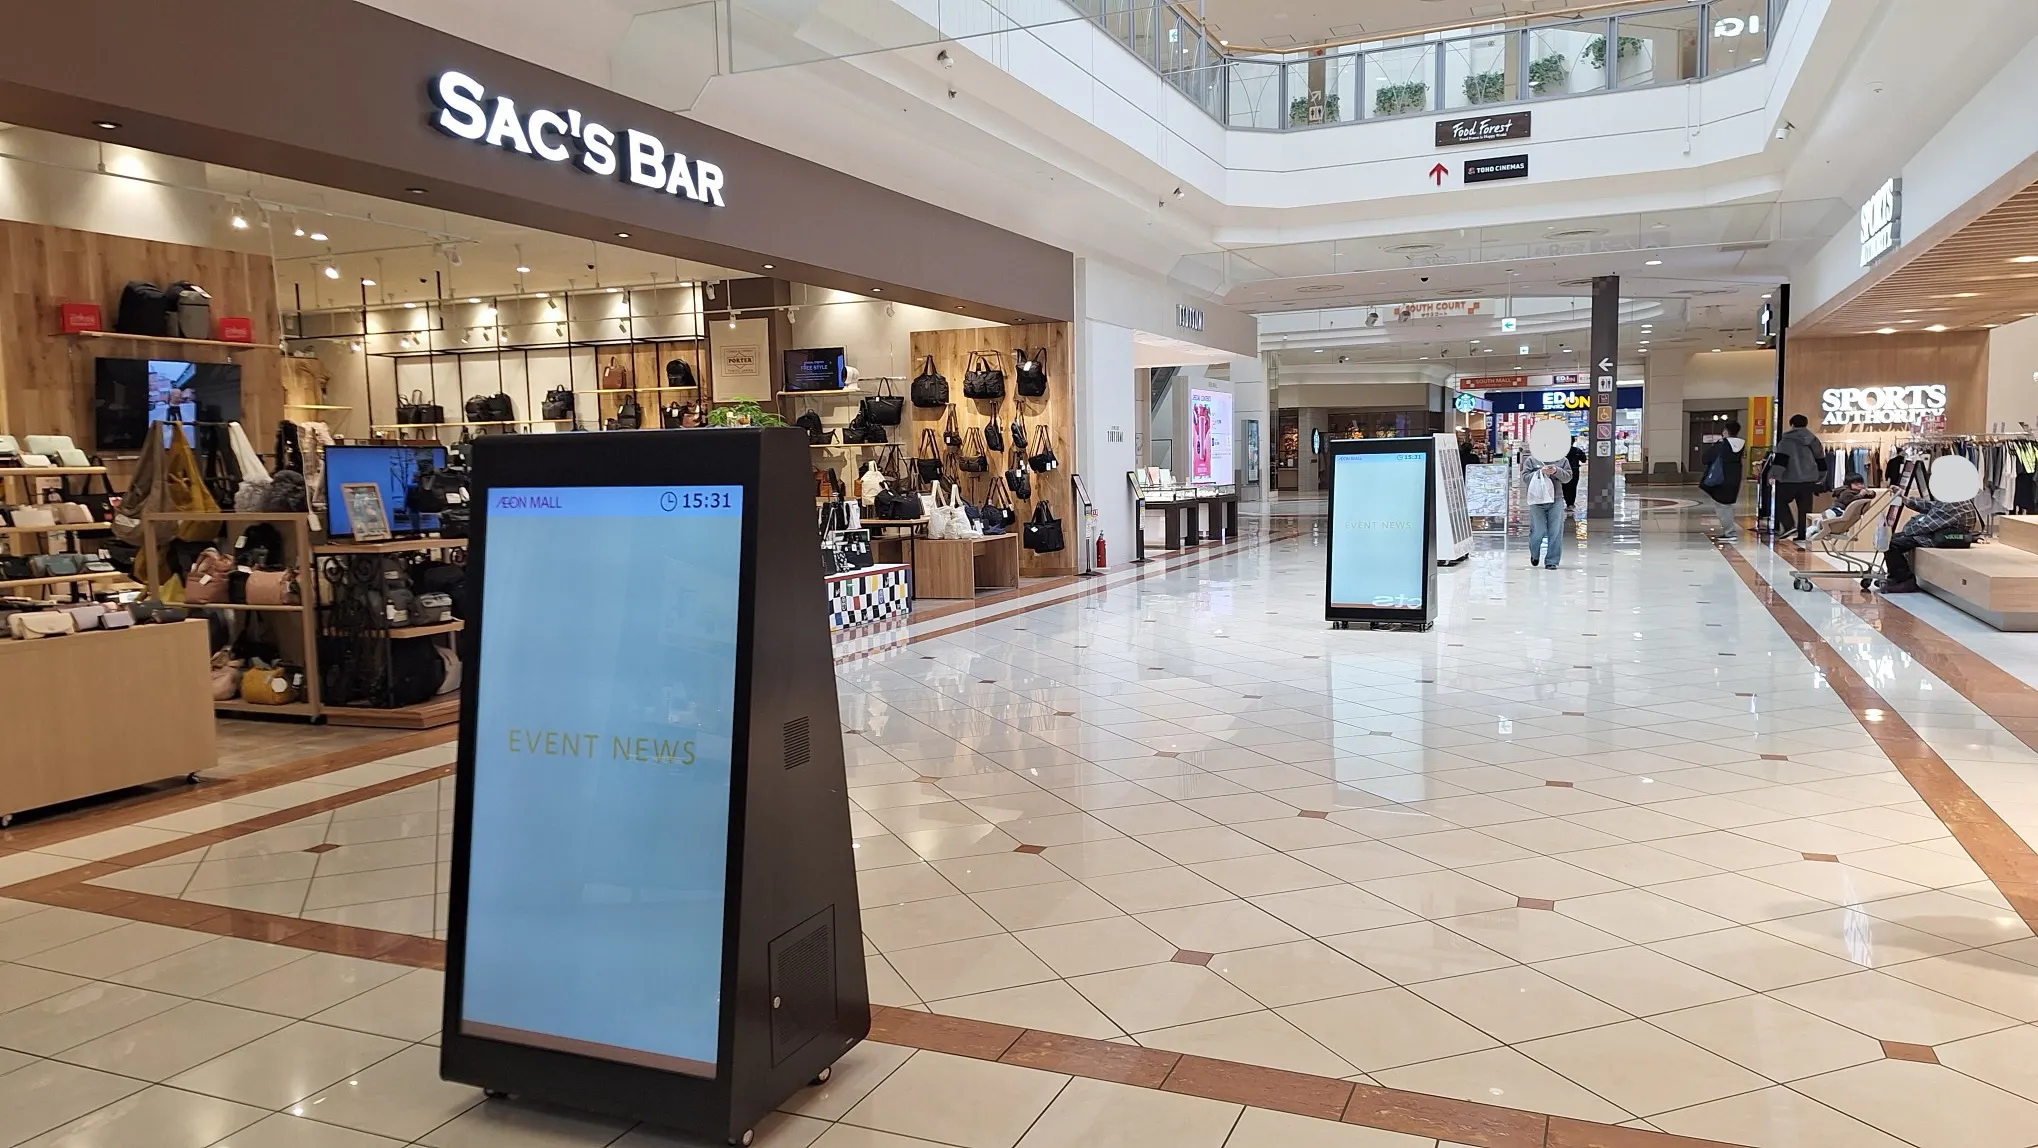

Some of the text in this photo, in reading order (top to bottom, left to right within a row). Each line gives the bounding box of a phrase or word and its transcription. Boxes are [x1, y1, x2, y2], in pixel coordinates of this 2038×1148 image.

[1452, 118, 1513, 138] Food Forest
[439, 70, 726, 208] SAC'S BAR
[1476, 162, 1525, 174] TOHO CINEMAS
[1436, 301, 1466, 310] COURT
[1821, 384, 1947, 411] SPORTS
[530, 495, 562, 509] MALL
[682, 492, 731, 509] 15:31
[1345, 521, 1412, 530] EVENT NEWS
[508, 729, 696, 766] EVENT NEWS
